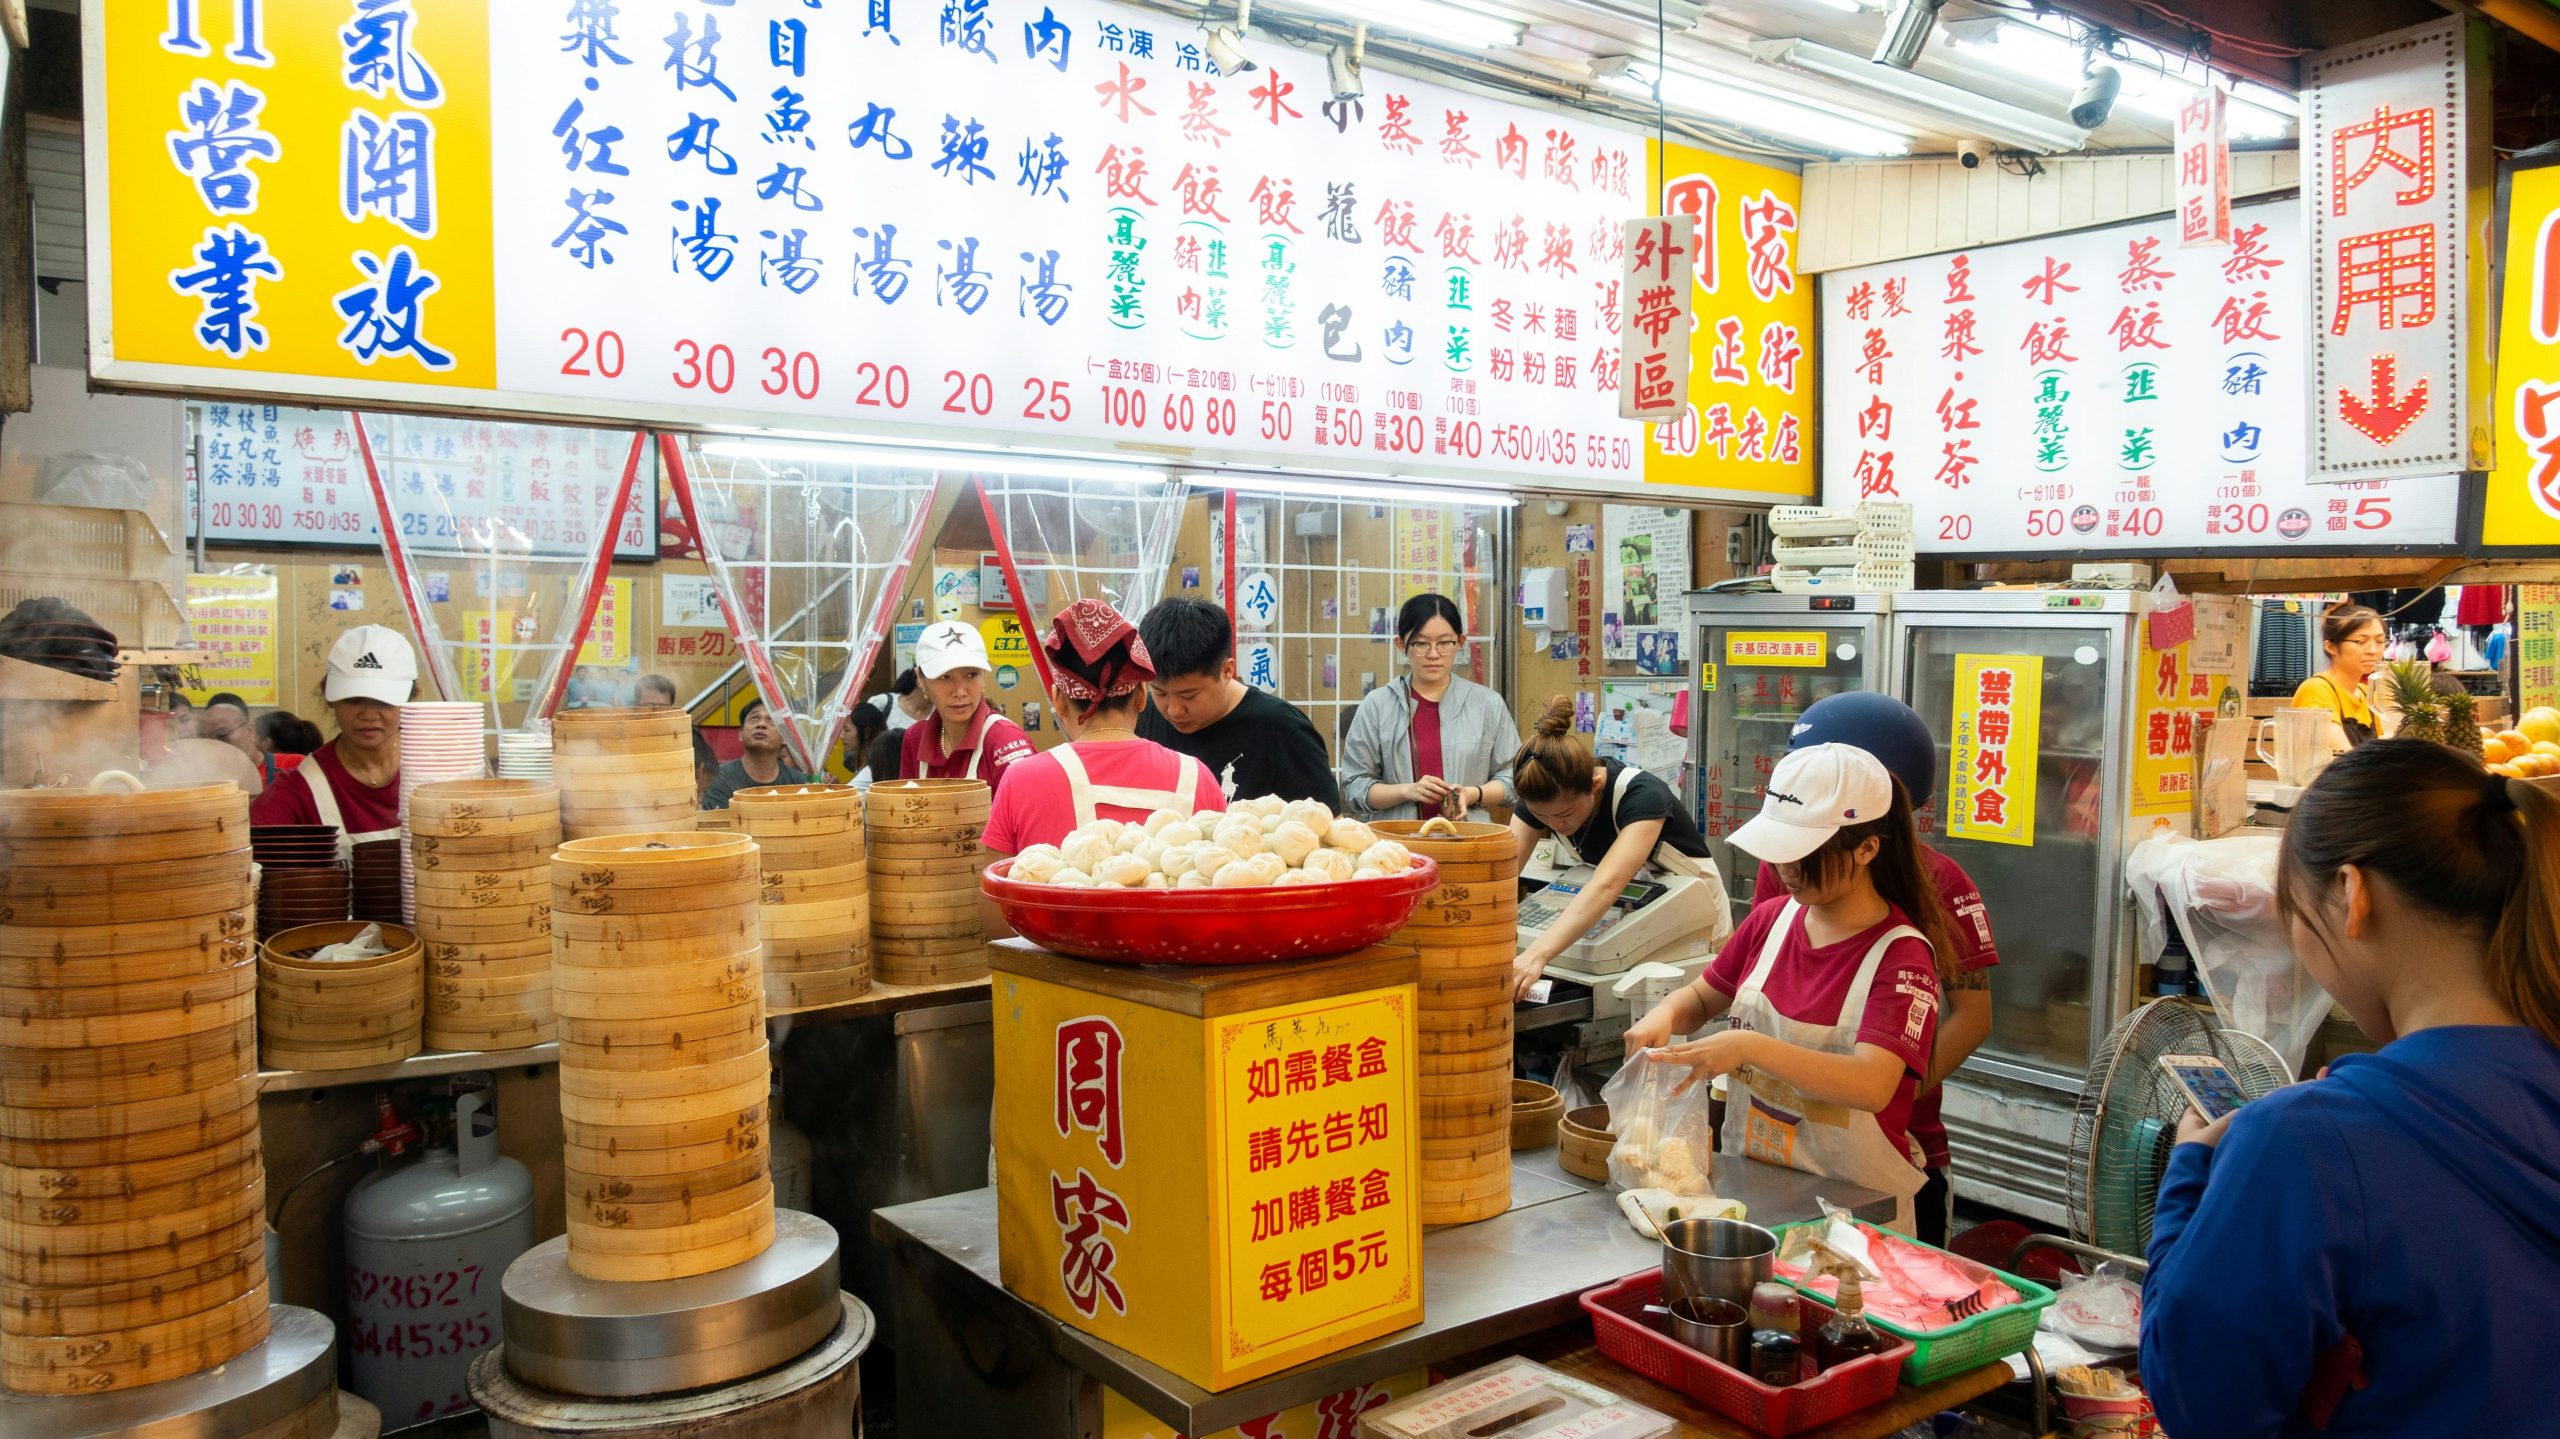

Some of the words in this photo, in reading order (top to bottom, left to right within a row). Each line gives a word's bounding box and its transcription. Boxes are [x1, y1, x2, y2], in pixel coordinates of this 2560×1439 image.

[1098, 20, 1154, 59] 冷凍
[661, 0, 738, 283] 枝丸湯
[757, 0, 822, 294] 目魚丸湯
[1632, 221, 1684, 411] 外帶區
[1846, 276, 1912, 321] 特製
[560, 327, 625, 379] 20
[672, 338, 735, 394] 30
[760, 347, 820, 400] 30
[1690, 318, 1802, 391] 正街
[856, 362, 910, 409] 20
[943, 370, 994, 415] 20
[1023, 377, 1071, 423] 25
[1102, 385, 1146, 428] 100
[1163, 393, 1194, 432] 60
[1206, 397, 1236, 436] 80
[1261, 400, 1292, 441] 50
[1333, 407, 1362, 447] 50
[1389, 414, 1424, 454] 30
[1655, 405, 1801, 463] 40年老店
[1853, 328, 1899, 499] 魯肉飯
[1449, 420, 1482, 458] 40
[1587, 435, 1606, 468] 55
[1611, 437, 1631, 470] 50
[212, 502, 231, 527] 20
[238, 503, 257, 528] 30
[262, 504, 281, 529] 30
[402, 512, 428, 536] 25
[1938, 514, 1972, 541] 20
[2026, 509, 2064, 537] 50
[2122, 508, 2163, 537] 40
[2223, 503, 2270, 534] 30
[2352, 497, 2392, 530] 5
[562, 530, 587, 544] 30
[624, 529, 643, 547] 40
[1246, 580, 1276, 689] 冷氣
[1973, 669, 2012, 825] 禁帶外食
[2147, 711, 2215, 756] 寄放
[2158, 773, 2194, 795] 謝謝配
[1246, 1036, 1388, 1105] 如需餐盒
[1248, 1102, 1389, 1174] 請先告知
[1051, 1019, 1128, 1316] 周家
[1250, 1168, 1391, 1243] 加購餐盒
[1258, 1230, 1388, 1303] 每個5元
